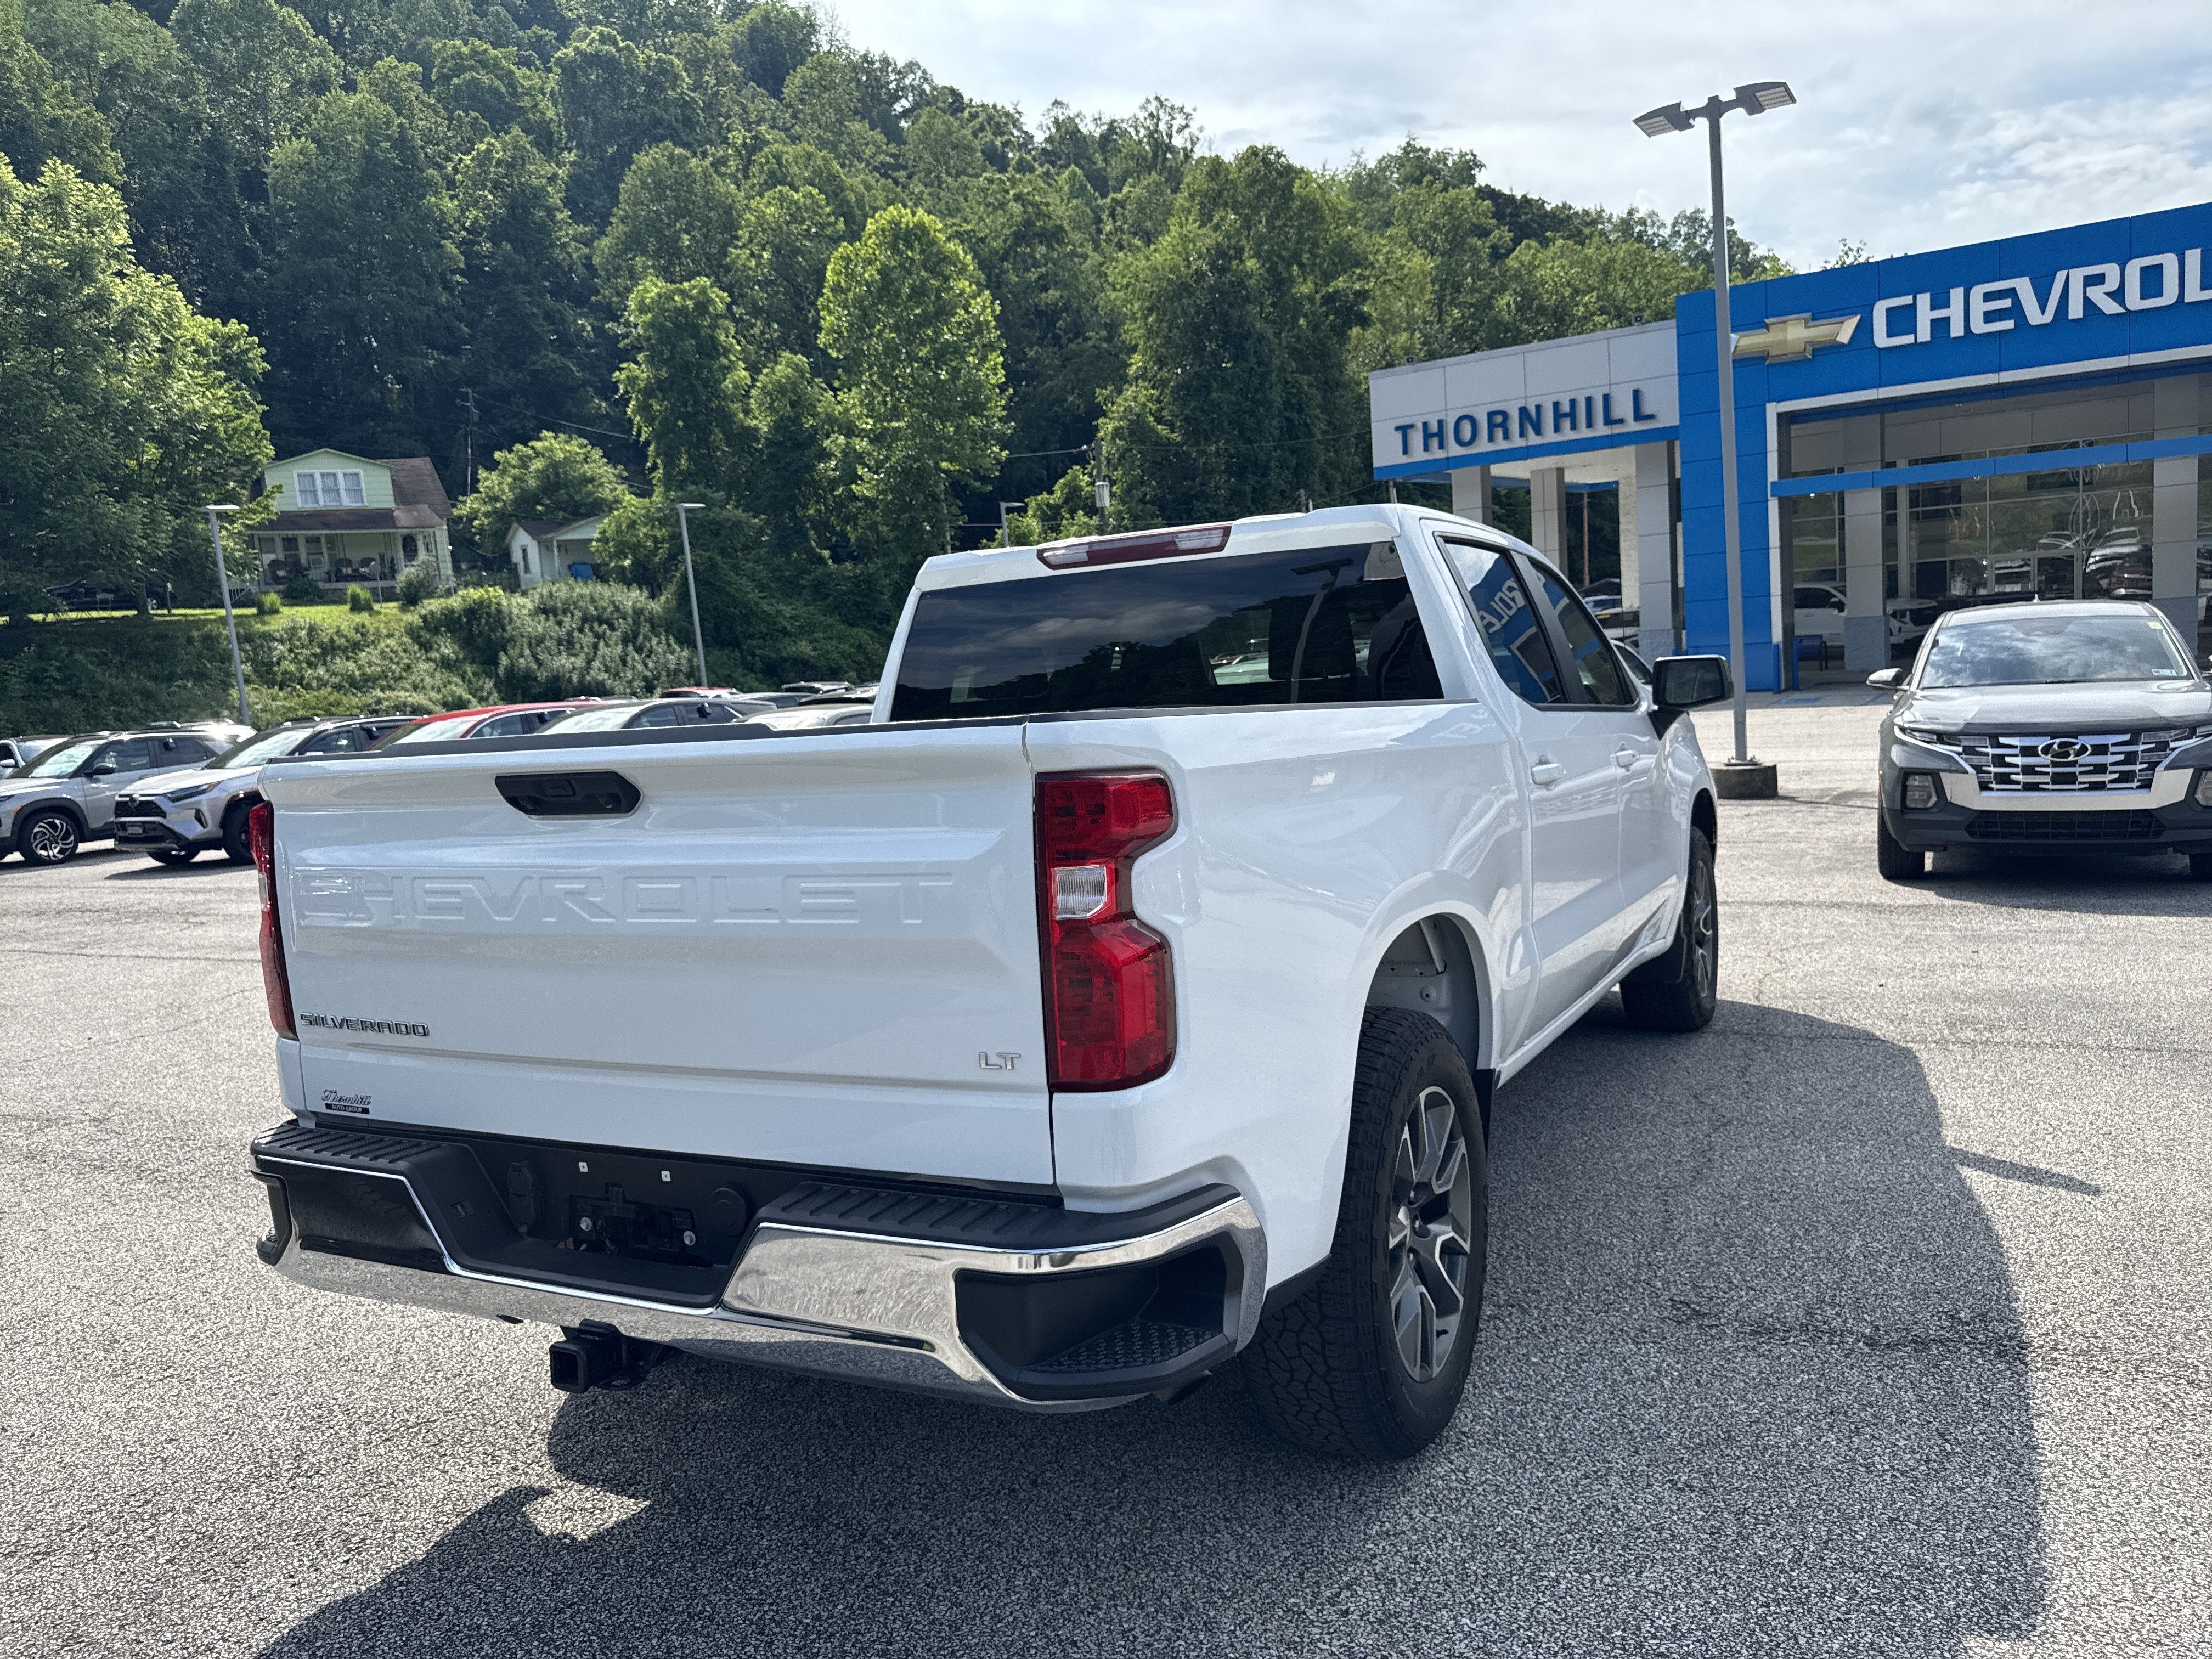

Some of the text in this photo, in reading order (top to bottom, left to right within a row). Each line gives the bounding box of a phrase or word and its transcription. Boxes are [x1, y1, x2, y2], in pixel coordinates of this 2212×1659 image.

[1394, 388, 1656, 456] THORNHILL
[300, 873, 953, 923] CHEVROLET
[300, 1012, 430, 1036] SILVERADO
[978, 1051, 1021, 1070] LT
[321, 1089, 371, 1105] Thornhill
